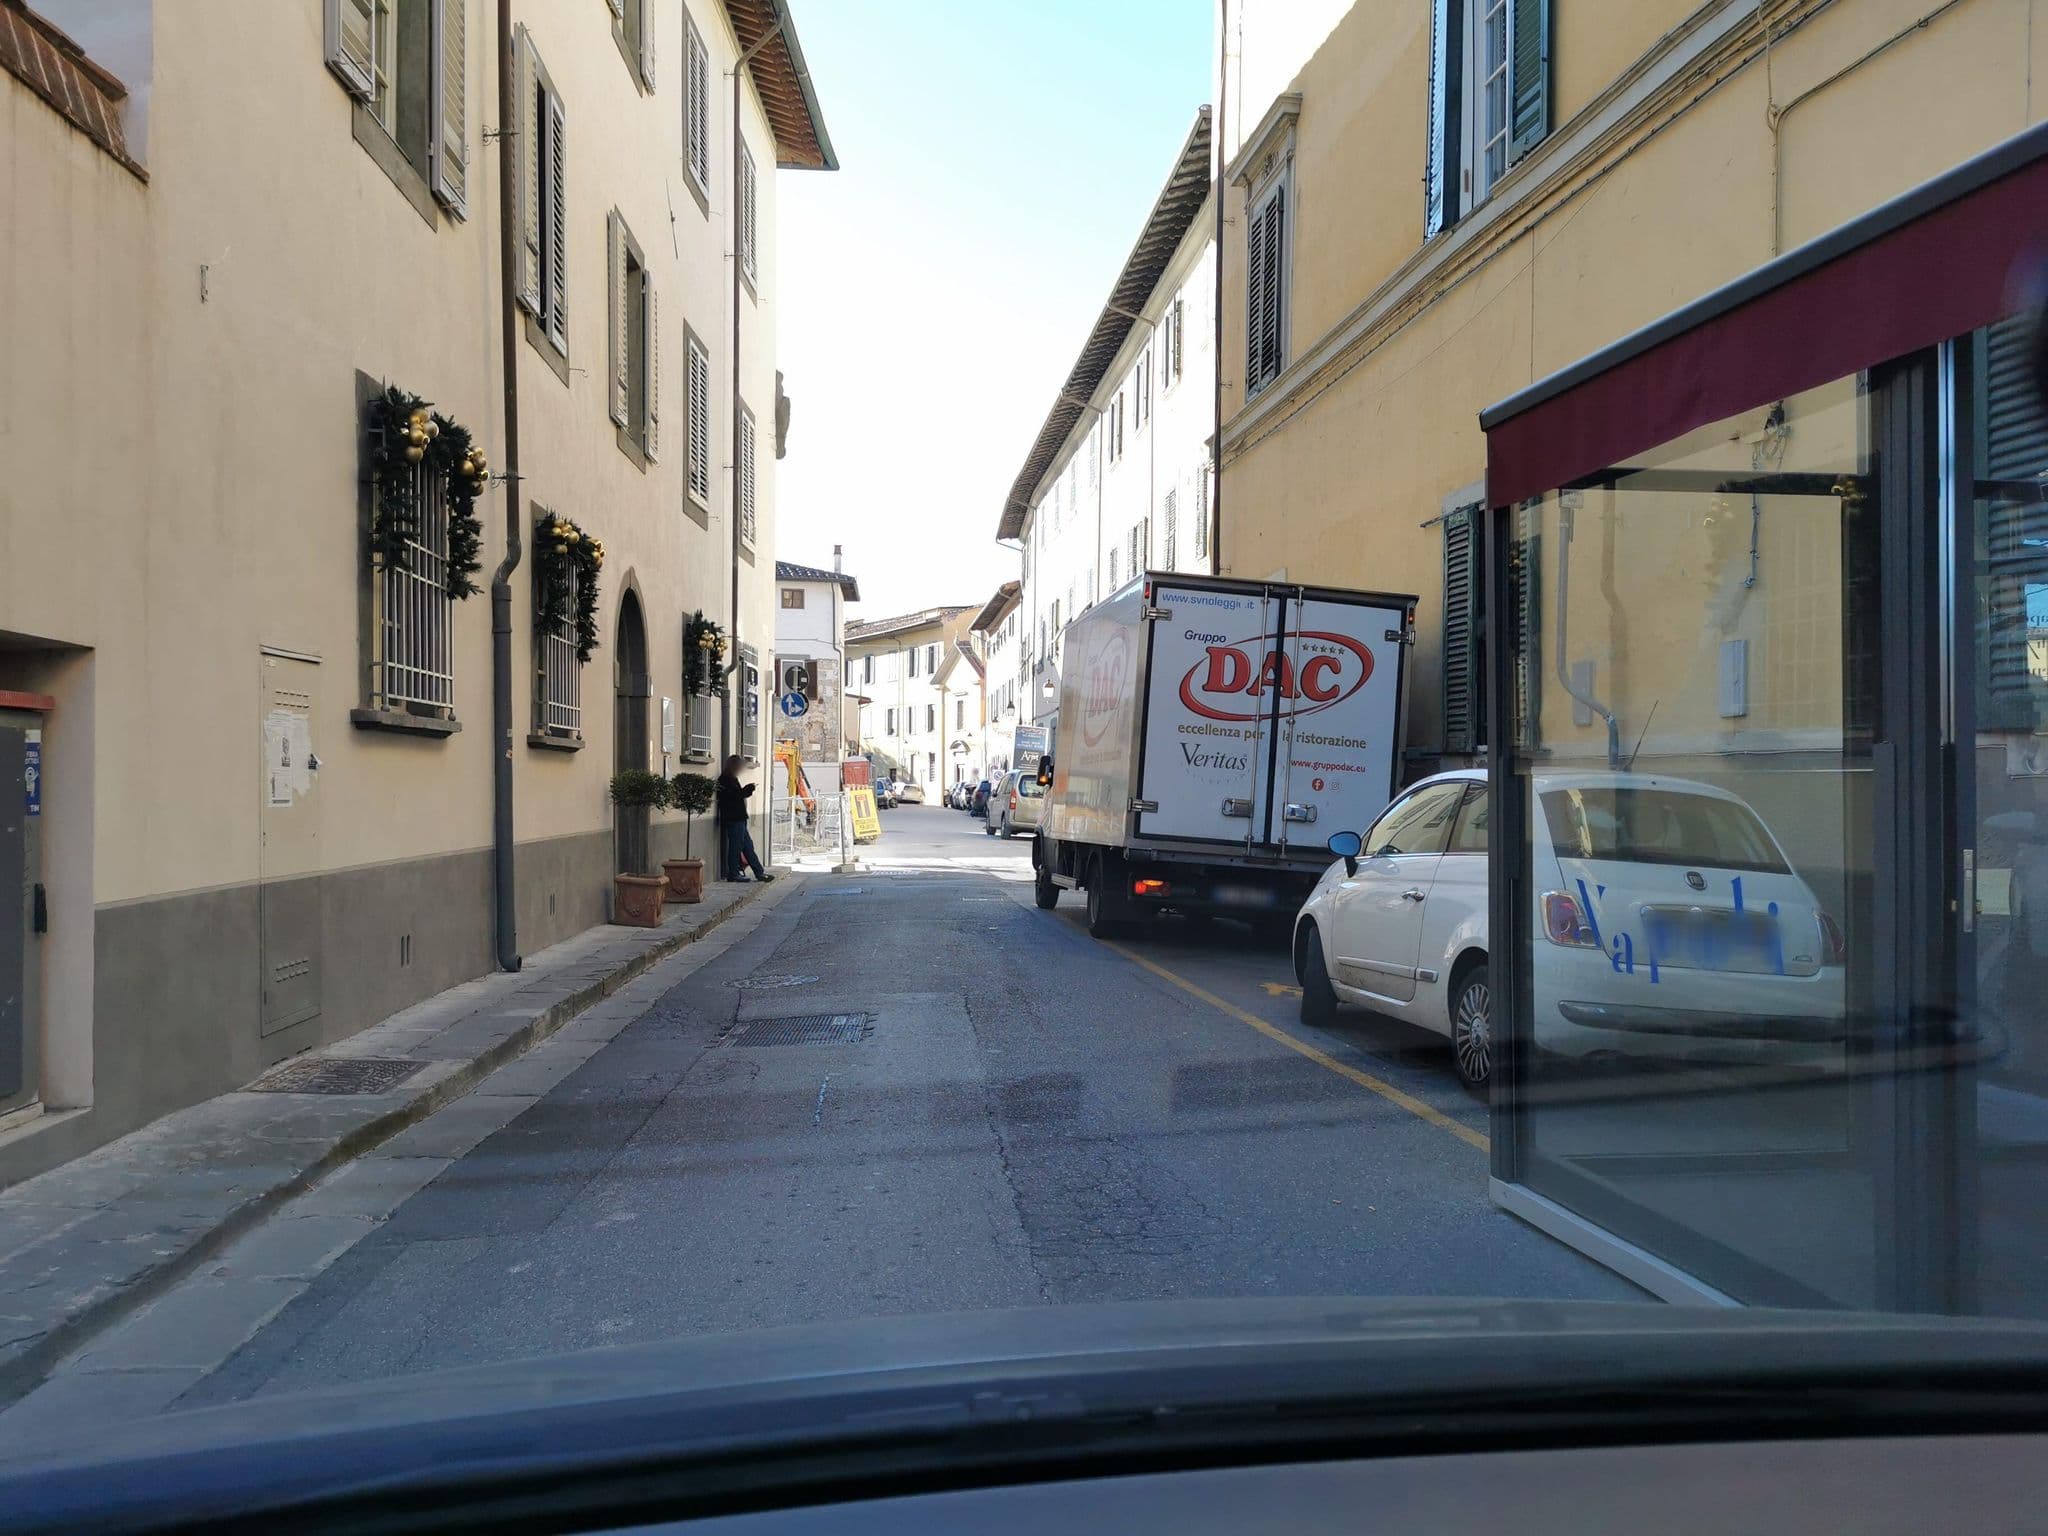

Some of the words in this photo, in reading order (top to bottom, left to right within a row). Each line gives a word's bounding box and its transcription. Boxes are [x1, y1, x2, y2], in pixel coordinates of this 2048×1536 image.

[1184, 629, 1227, 644] Gruppo
[1202, 646, 1342, 702] DAC
[1177, 723, 1241, 738] eccellenza
[1244, 730, 1265, 741] per
[1296, 731, 1367, 749] ristorazione
[1180, 742, 1248, 771] Veritas
[1290, 760, 1366, 773] www.gruppodac.eu
